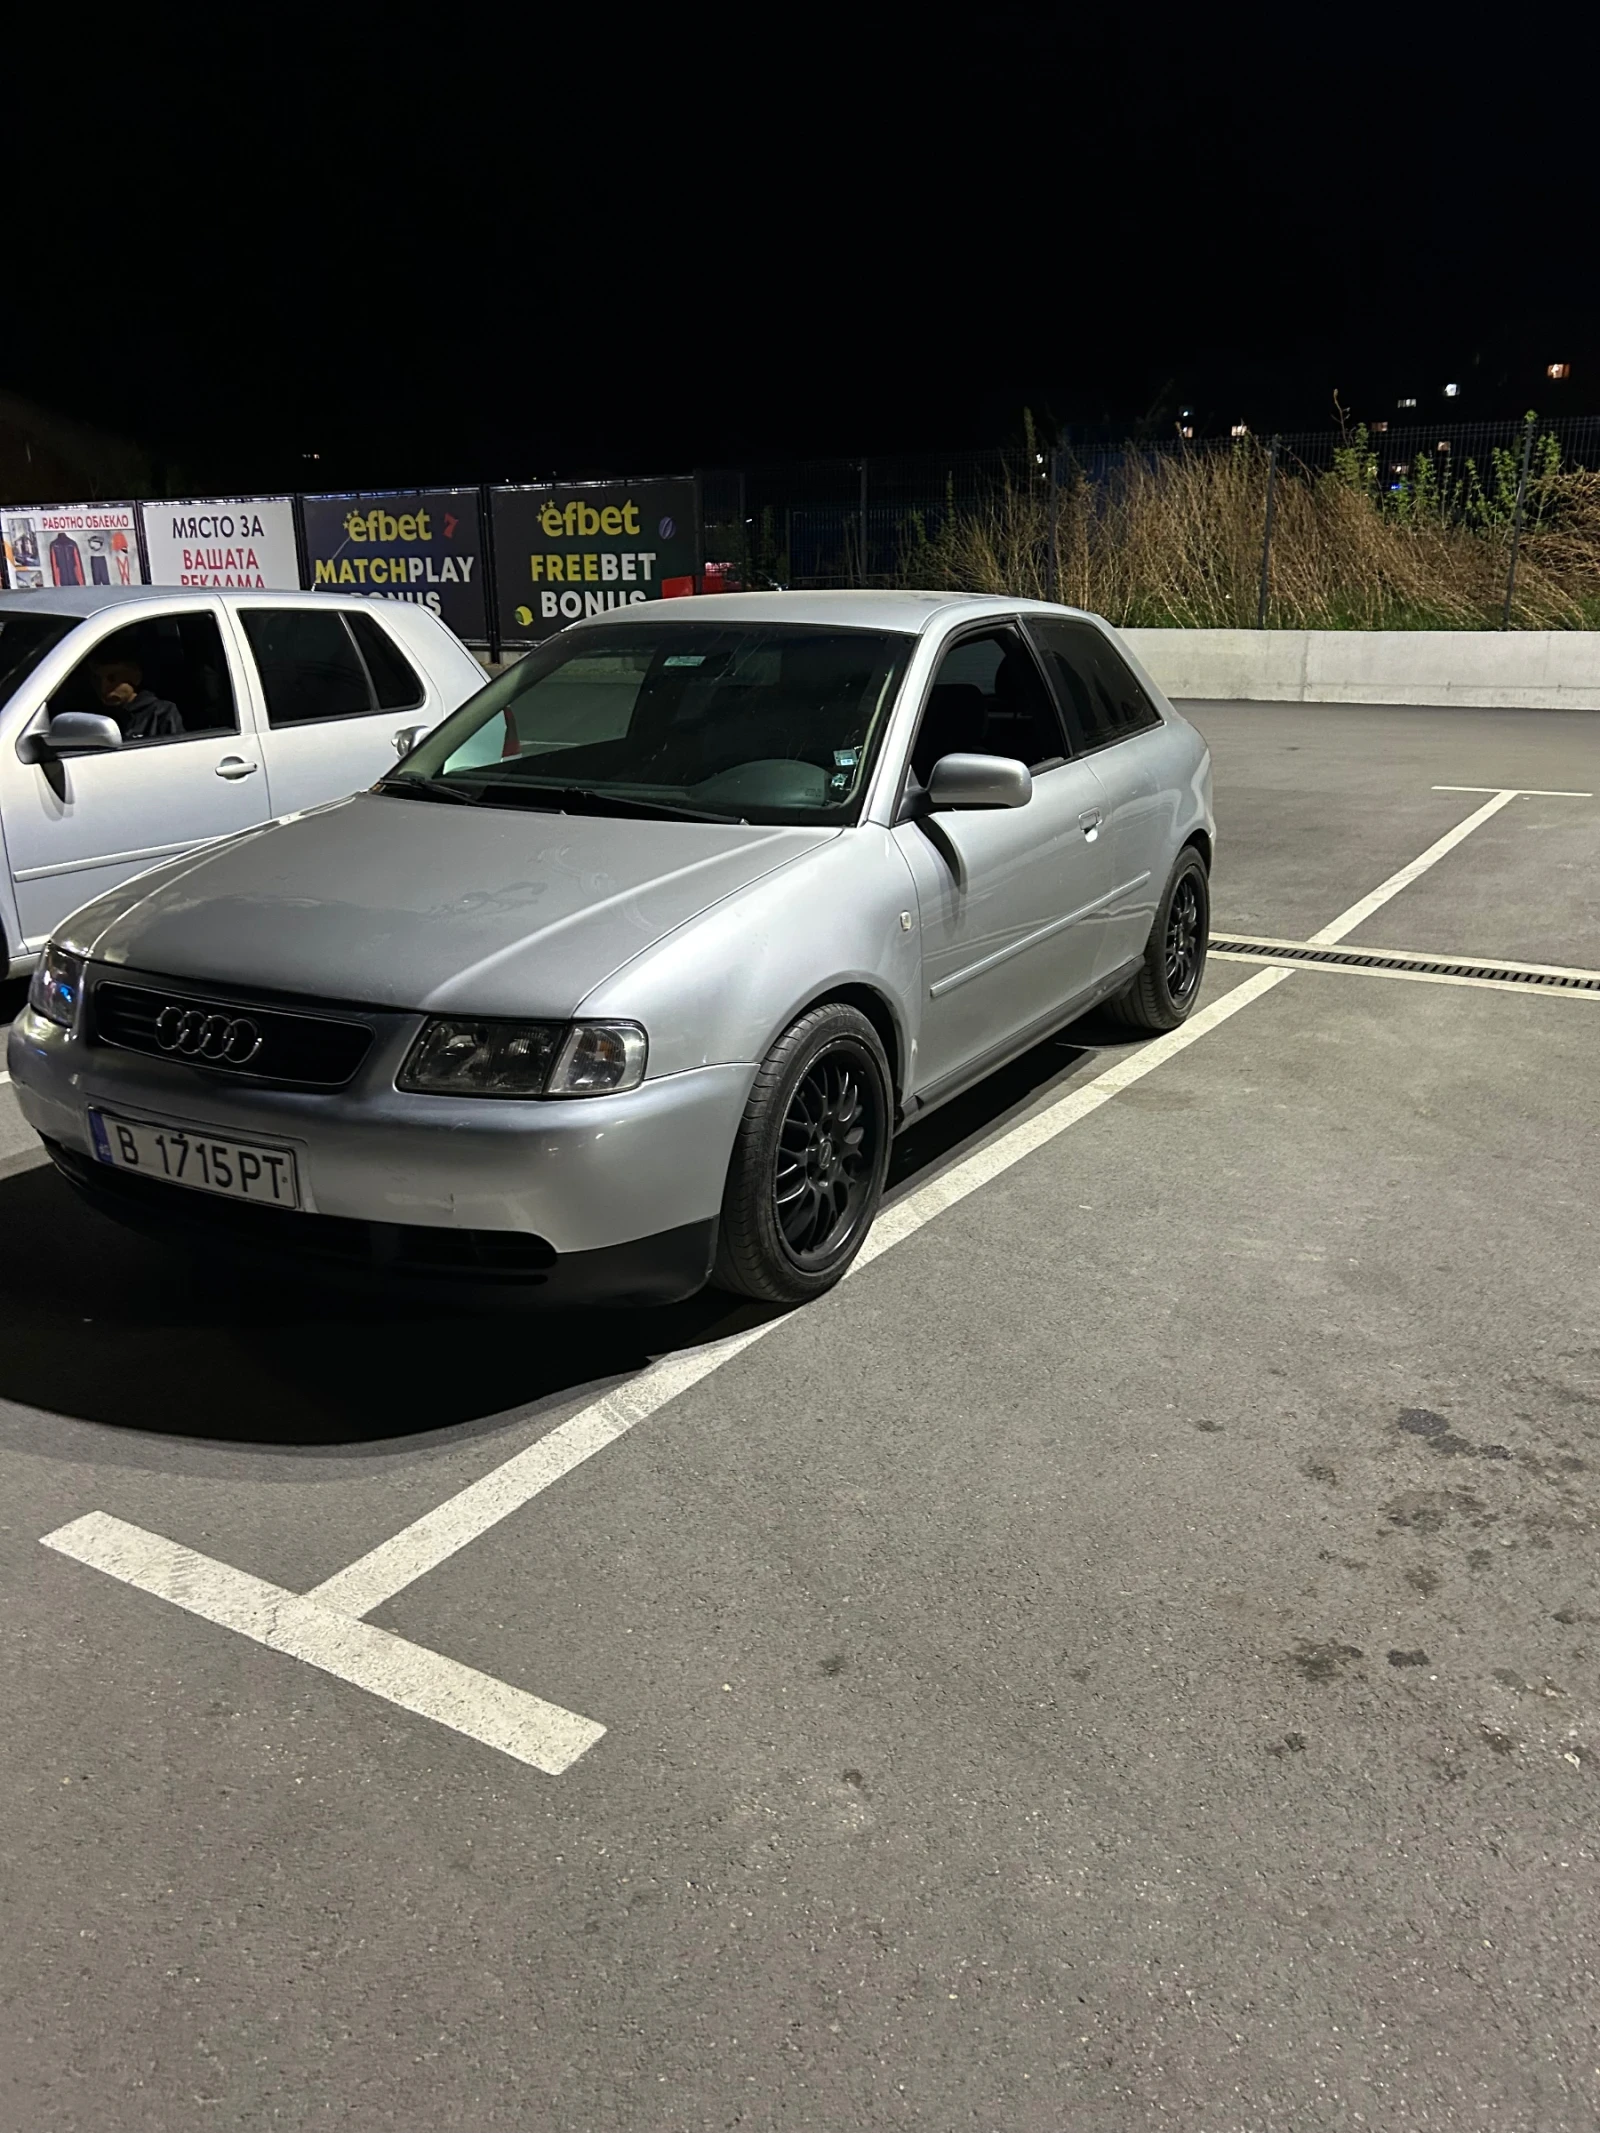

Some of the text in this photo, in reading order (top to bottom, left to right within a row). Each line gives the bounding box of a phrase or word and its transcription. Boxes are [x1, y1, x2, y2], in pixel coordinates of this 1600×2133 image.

[42, 514, 129, 530] РАБОТНО ОБЛЕКЛО
[172, 515, 265, 539] МЯСТО ЗА
[348, 507, 433, 542] efbet
[541, 499, 641, 537] efbet
[182, 548, 260, 570] ВАШАТА
[315, 556, 475, 585] MATCHPLAY
[530, 552, 657, 582] FREEBET
[115, 1125, 140, 1165] B
